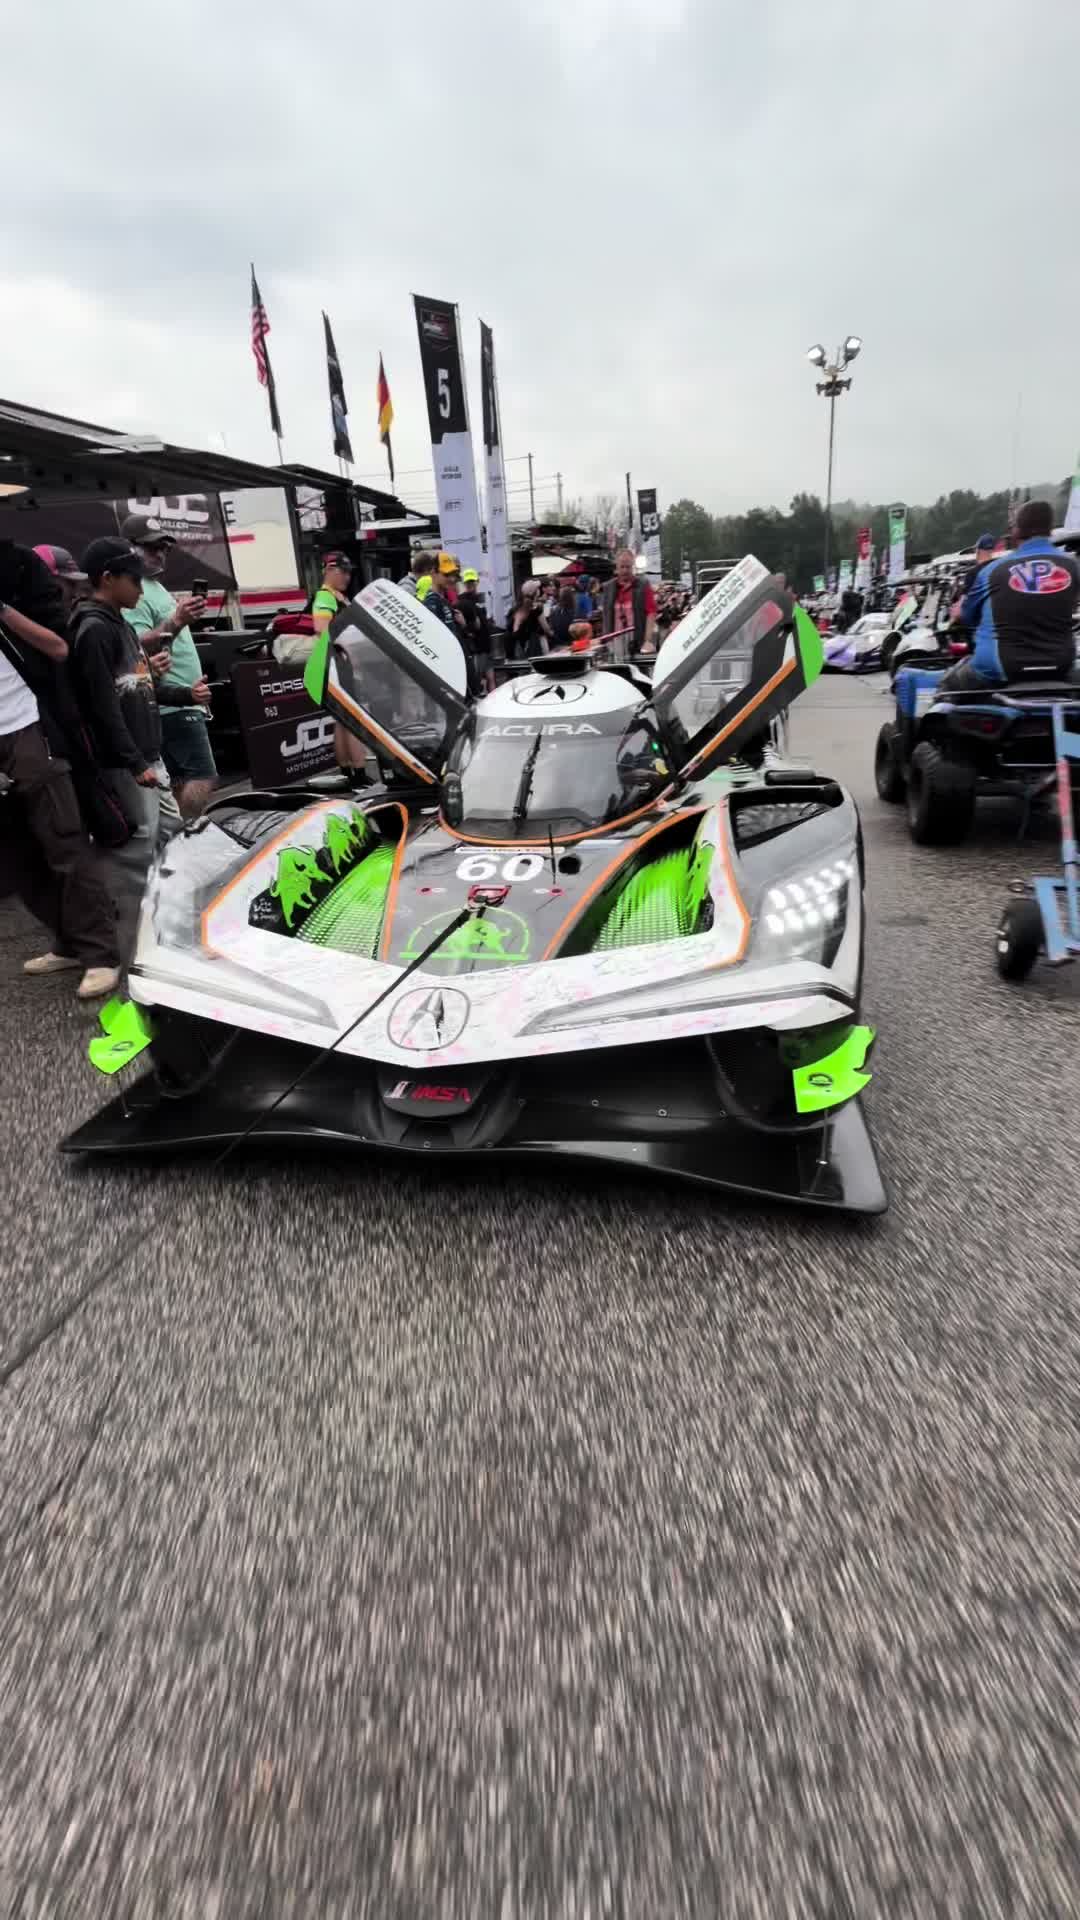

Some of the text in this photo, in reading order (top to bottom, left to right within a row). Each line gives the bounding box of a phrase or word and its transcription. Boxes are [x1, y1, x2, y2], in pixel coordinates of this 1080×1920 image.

[437, 367, 451, 419] 5
[1008, 560, 1055, 593] VP
[379, 598, 422, 635] BRAUN
[260, 678, 304, 696] PORS
[479, 723, 603, 737] ACURA
[455, 853, 545, 882] 60
